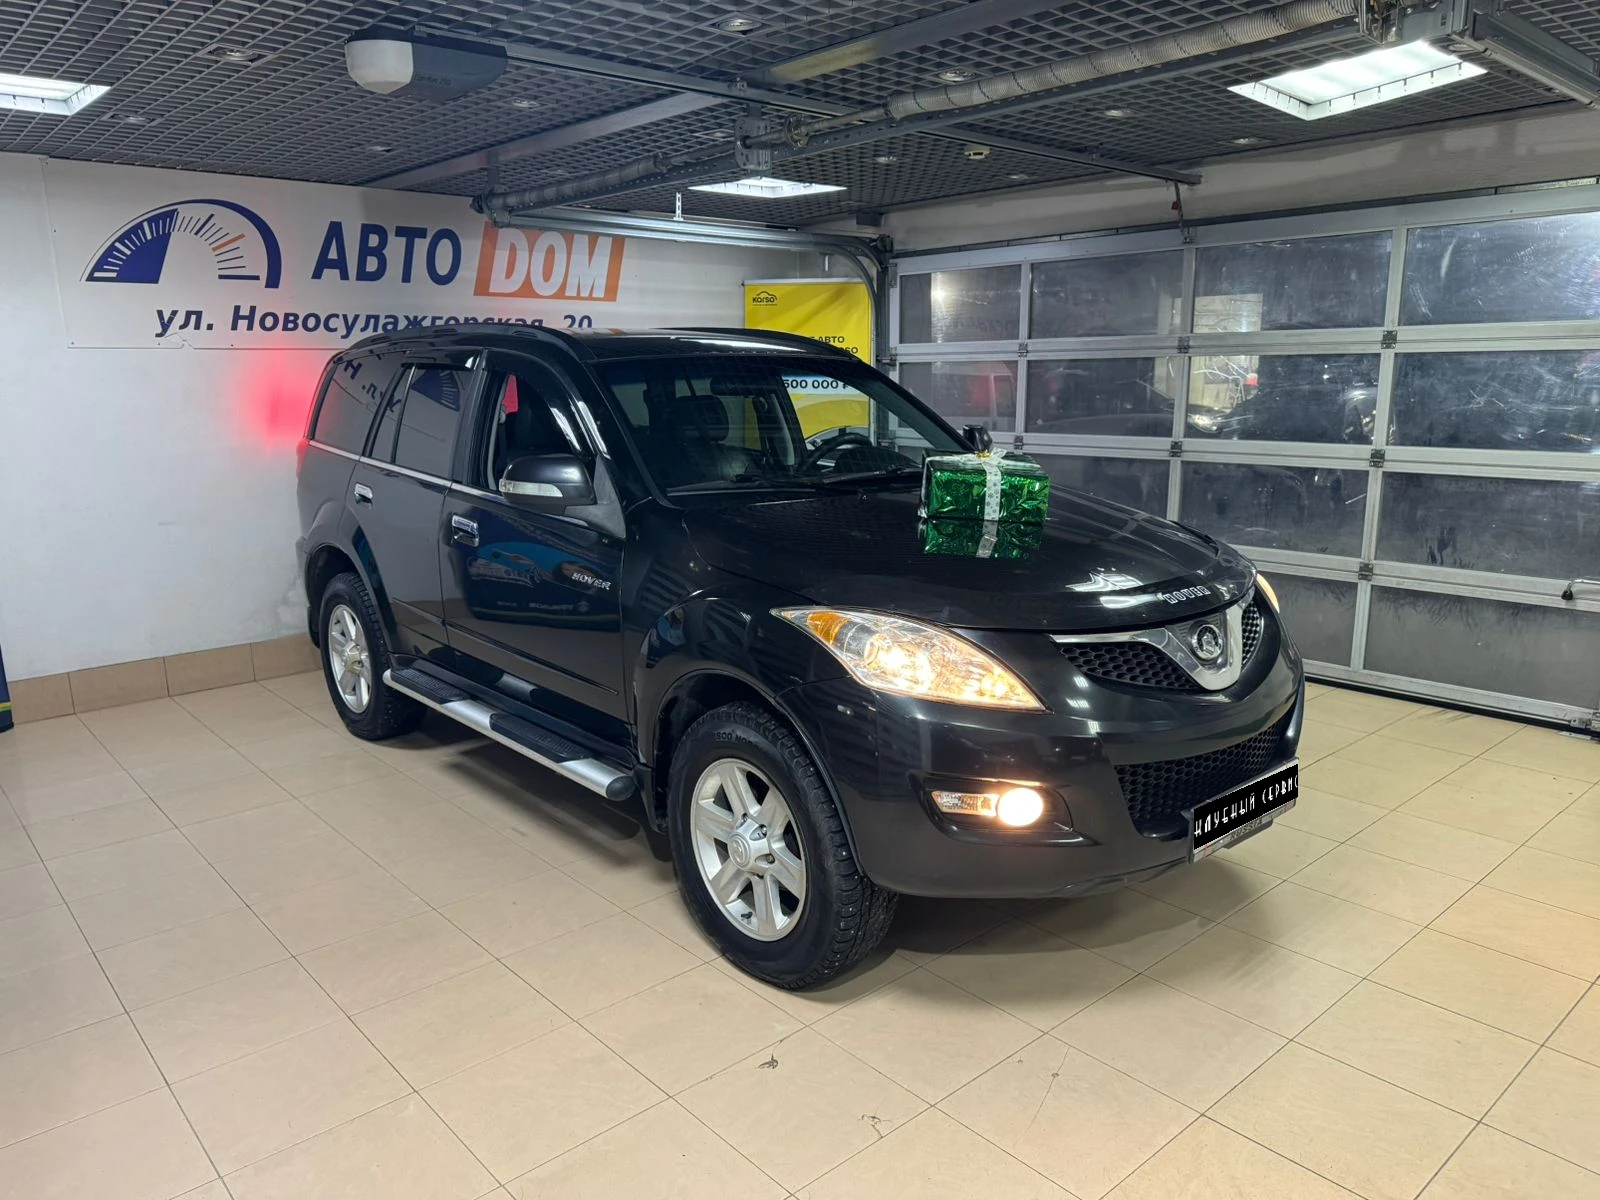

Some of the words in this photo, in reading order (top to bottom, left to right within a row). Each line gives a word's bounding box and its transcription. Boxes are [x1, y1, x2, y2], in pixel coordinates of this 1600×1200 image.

[311, 219, 463, 286] АВТО
[488, 229, 609, 298] DOM
[154, 309, 214, 338] ул.
[563, 314, 593, 330] 20
[571, 572, 612, 591] HOVER
